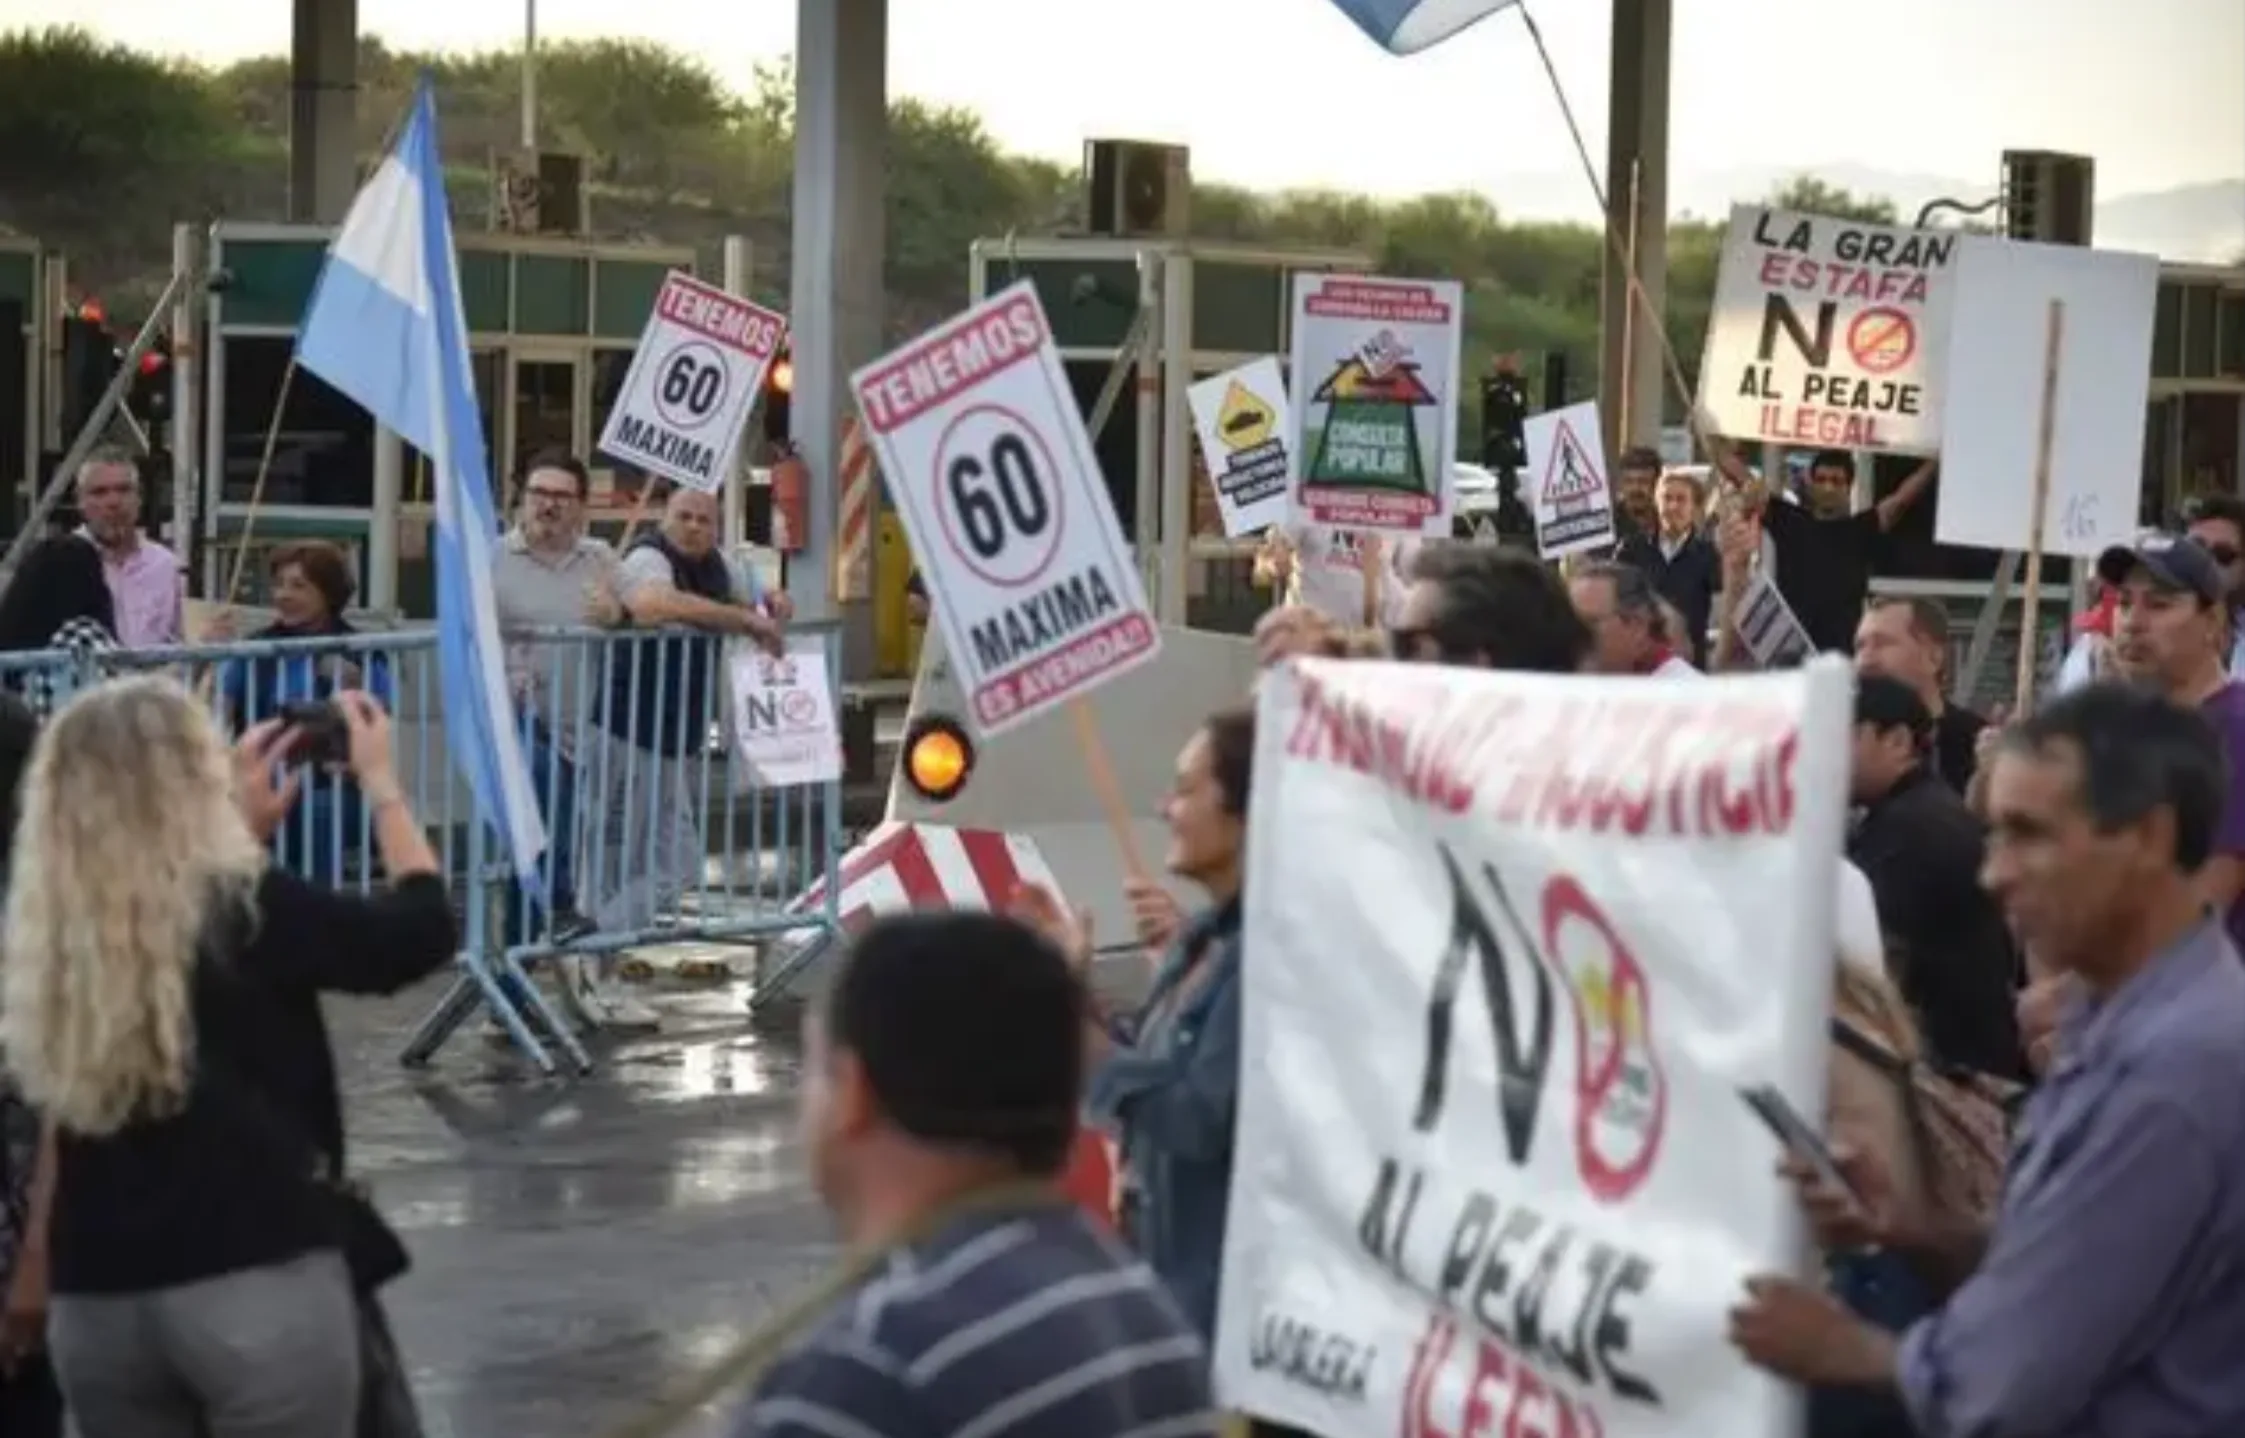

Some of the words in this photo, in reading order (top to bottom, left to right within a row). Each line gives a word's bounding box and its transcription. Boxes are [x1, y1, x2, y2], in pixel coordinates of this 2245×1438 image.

[1755, 211, 1812, 253] LA
[1835, 230, 1955, 268] GRAN
[1760, 253, 1928, 302] ESTAFA
[660, 283, 777, 354] TENEMOS
[663, 354, 721, 415] 60
[862, 304, 1039, 422] TENEMOS
[1739, 365, 1782, 400] AL
[1803, 373, 1921, 415] PEAJE
[615, 415, 715, 478] MAXIMA
[1759, 404, 1889, 447] ILEGAL
[947, 432, 1049, 560] 60
[971, 565, 1119, 674] MAXIMA
[1359, 1156, 1424, 1277] AL
[1440, 1188, 1664, 1406] PEAJE
